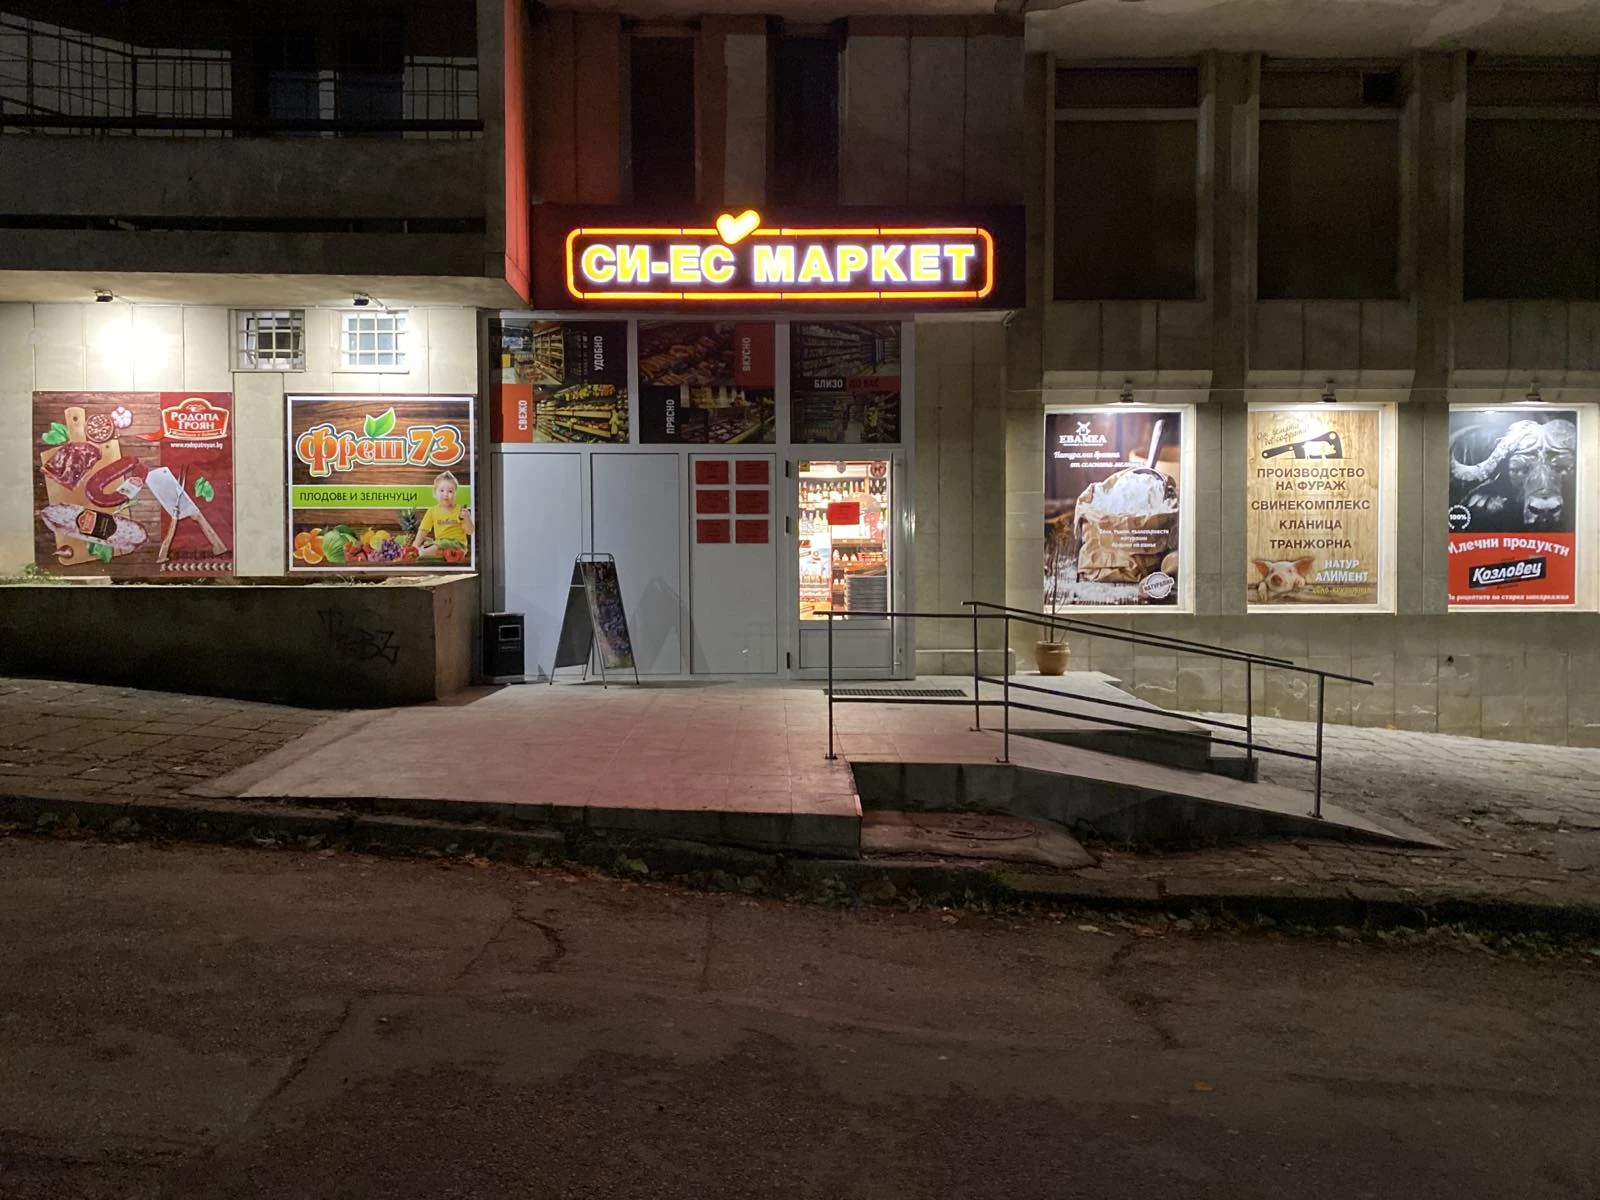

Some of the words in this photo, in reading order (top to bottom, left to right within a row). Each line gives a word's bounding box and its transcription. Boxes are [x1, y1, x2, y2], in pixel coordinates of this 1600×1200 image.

[581, 244, 736, 285] СИ-ЕС
[752, 244, 977, 285] МАРКЕТ
[593, 335, 605, 371] УДОБНО
[742, 337, 751, 372] ВКУСНО
[813, 379, 843, 389] БЛИЗО
[171, 411, 219, 421] РОДОПА
[517, 399, 528, 431] СВЕЖО
[665, 399, 676, 435] ПРЯСНО
[177, 420, 215, 430] ТРОЯН
[407, 425, 464, 463] 73
[1257, 468, 1365, 479] ПРОИЗВОДСТВО
[1276, 481, 1294, 490] НА
[1297, 480, 1346, 491] ФУРАЖ
[299, 491, 347, 503] ПЛОДОВЕ
[350, 491, 358, 502] И
[360, 491, 418, 503] ЗЕЛЕНЧУЦИ
[1251, 500, 1370, 510] СВИНЕКОМПЛЕКС
[1279, 520, 1342, 531] КЛАНИЦА
[1270, 540, 1352, 549] ТРАНЖОРНА
[1503, 537, 1570, 557] продукти
[1324, 559, 1360, 569] НАТУР
[1472, 562, 1542, 584] Козловец
